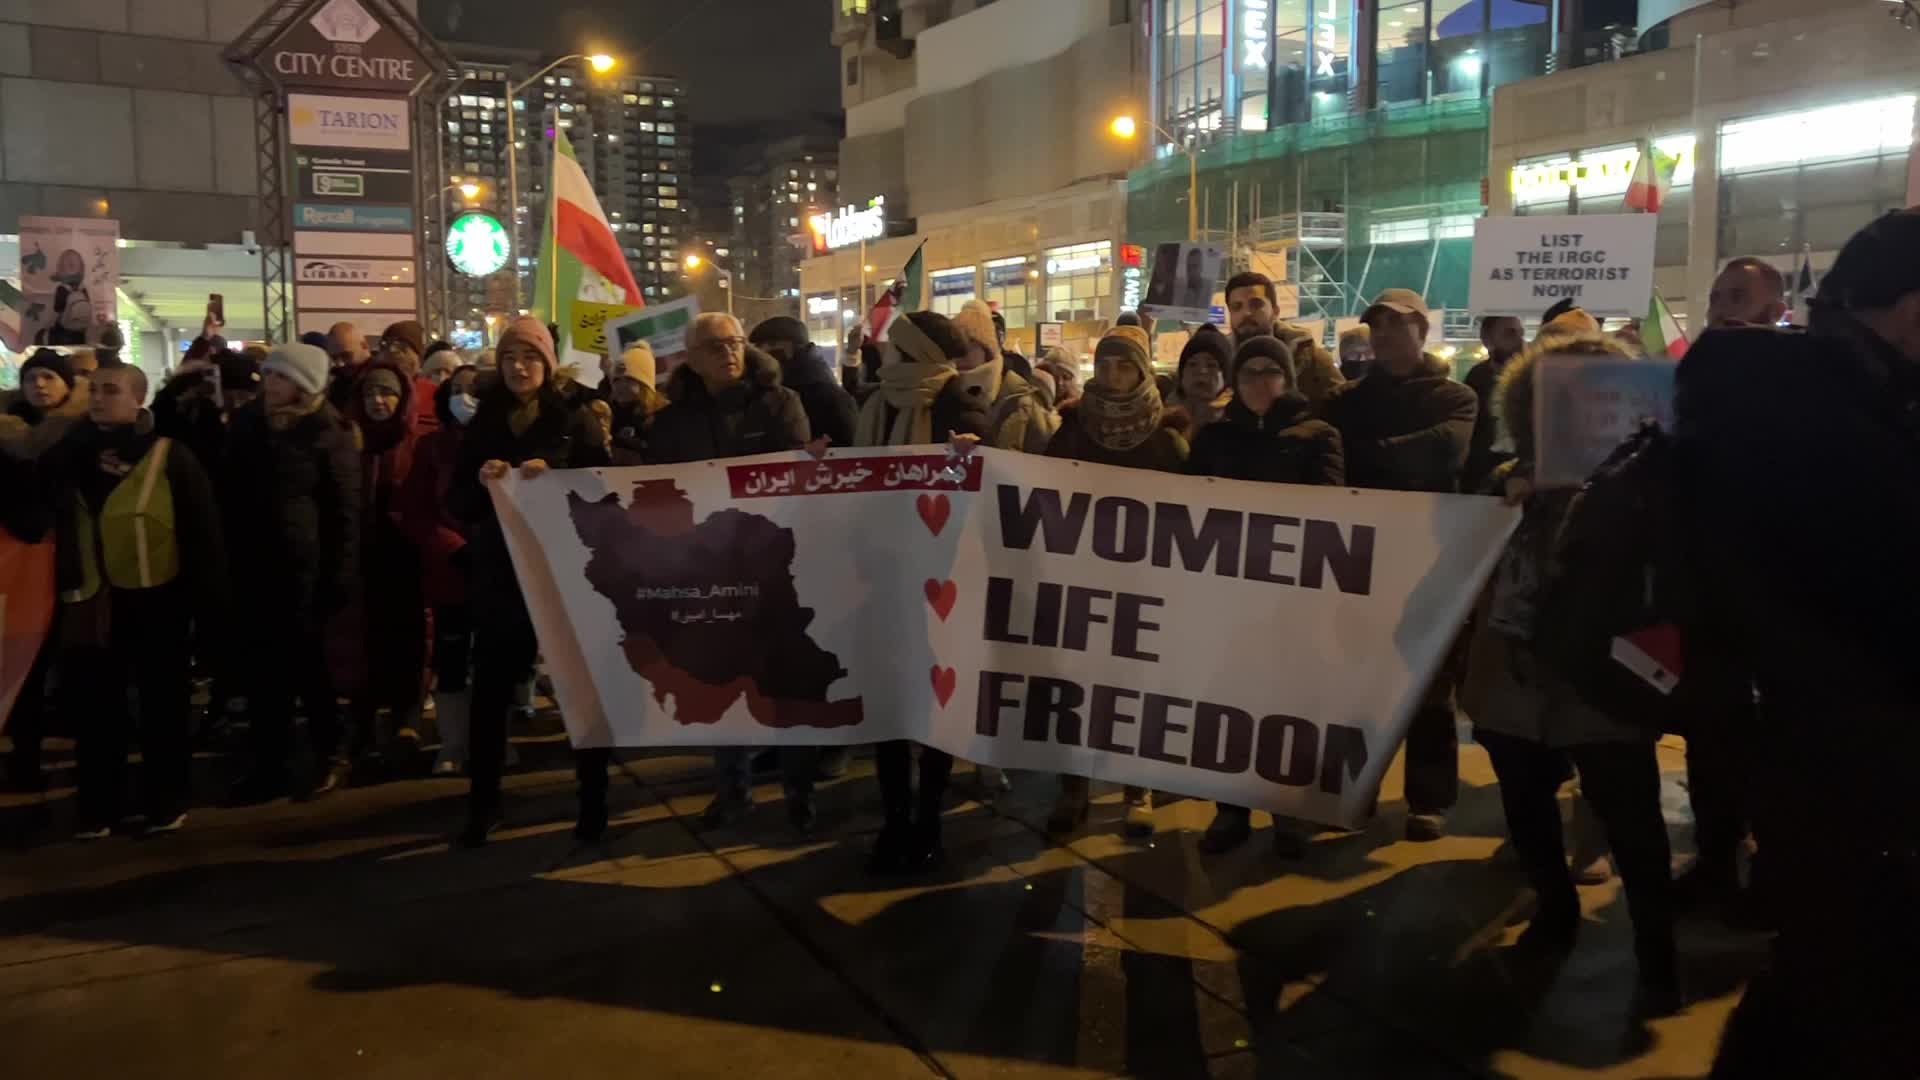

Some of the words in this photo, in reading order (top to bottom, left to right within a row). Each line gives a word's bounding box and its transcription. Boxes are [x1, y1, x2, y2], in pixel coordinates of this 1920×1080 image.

[274, 51, 327, 75] CITY
[330, 55, 415, 81] CENTRE
[319, 110, 400, 129] TARION
[1540, 234, 1584, 248] LIST
[1516, 251, 1553, 265] THE
[1559, 250, 1606, 264] IRGC
[303, 270, 369, 279] LIBRARY
[1489, 268, 1513, 281] AS
[1520, 267, 1630, 281] TERRORIST
[1532, 284, 1583, 297] NOW!
[745, 467, 796, 495] ایران
[997, 484, 1376, 595] WOMEN
[636, 582, 760, 600] #Mahsa_Amini
[983, 576, 1165, 662] LIFE
